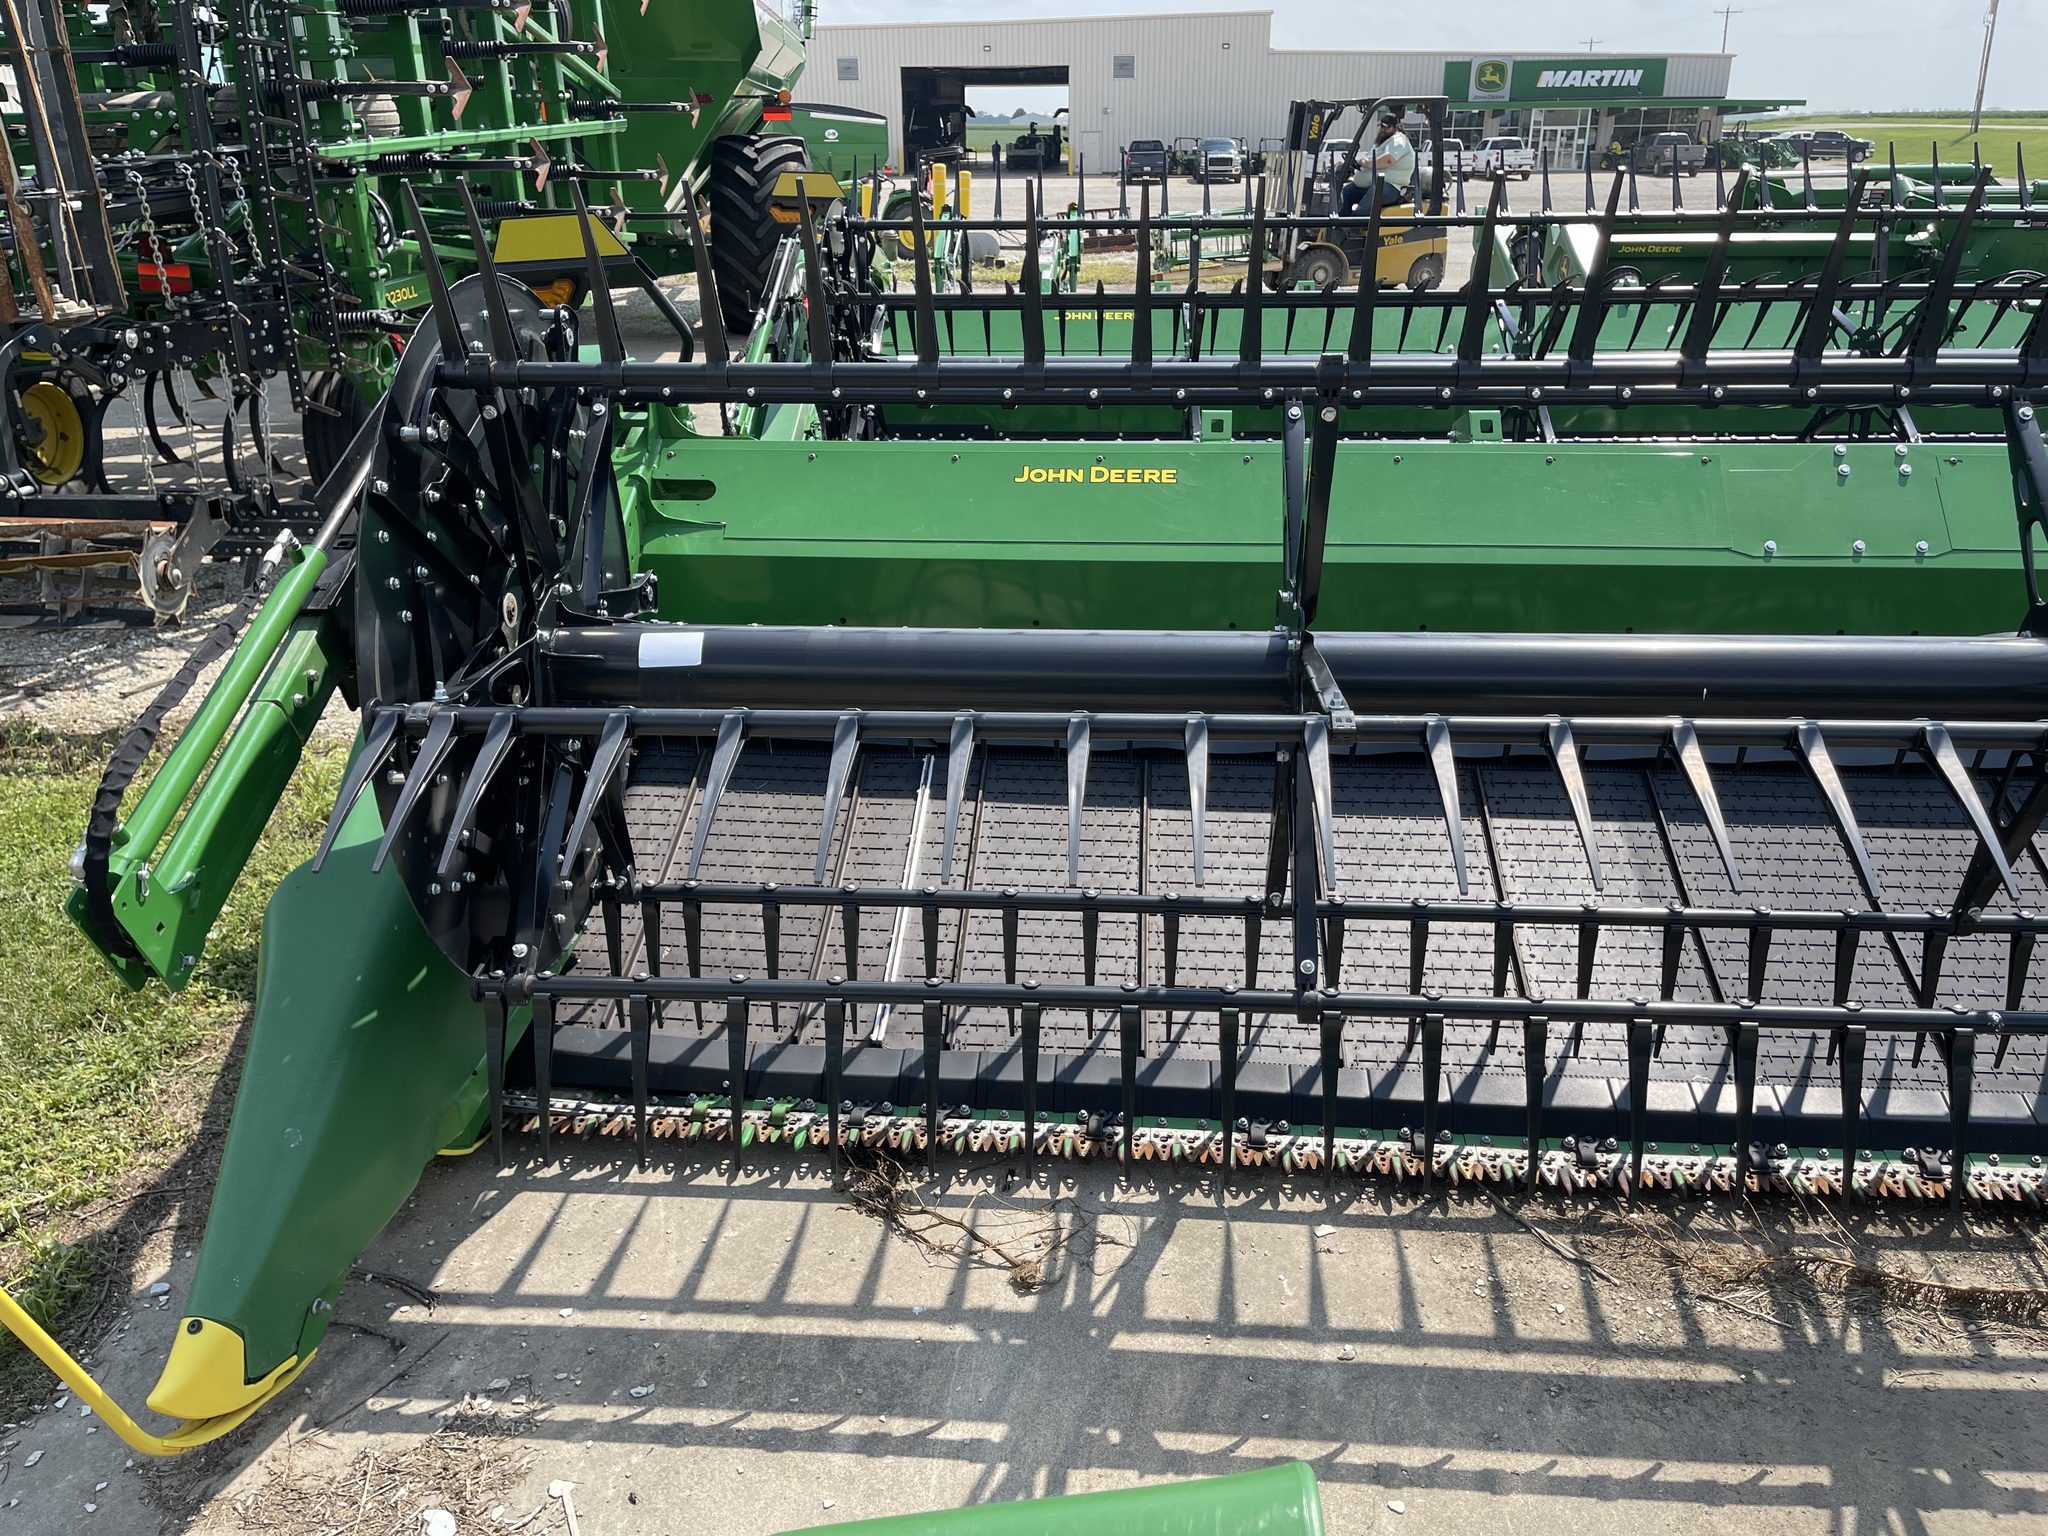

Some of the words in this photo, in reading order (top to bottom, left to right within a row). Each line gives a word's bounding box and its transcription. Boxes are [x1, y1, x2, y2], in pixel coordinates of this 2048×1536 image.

[1536, 69, 1644, 88] MARTIN
[1309, 114, 1320, 139] Yale
[1383, 234, 1404, 246] Yale
[1618, 245, 1647, 253] JOHN
[1647, 245, 1683, 253] DEERE
[1053, 311, 1092, 320] OHN
[1094, 310, 1135, 320] EER
[1014, 465, 1084, 483] JOHN
[1089, 466, 1178, 483] DEERE
